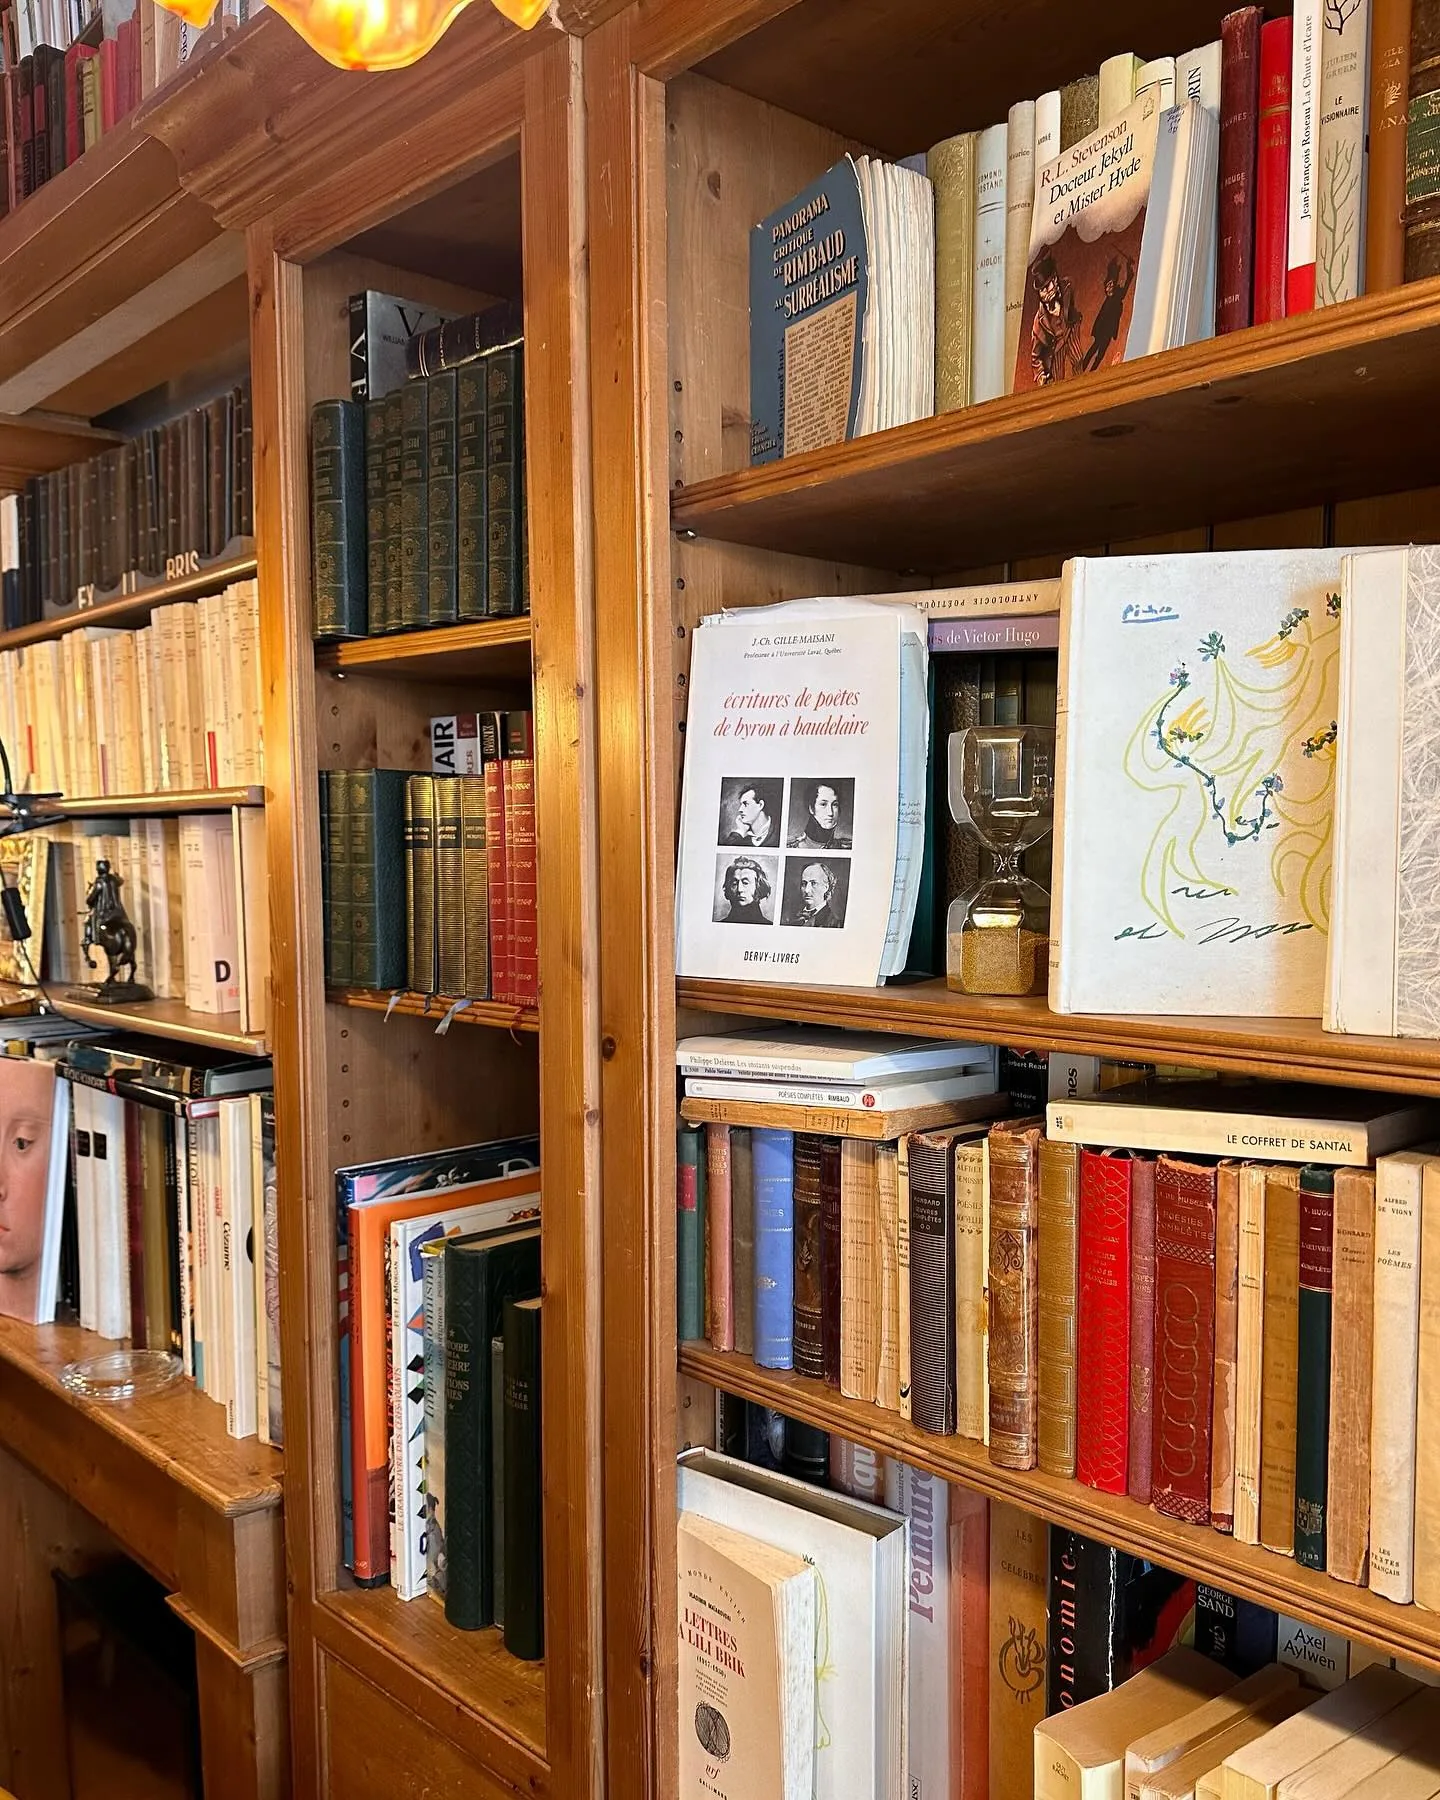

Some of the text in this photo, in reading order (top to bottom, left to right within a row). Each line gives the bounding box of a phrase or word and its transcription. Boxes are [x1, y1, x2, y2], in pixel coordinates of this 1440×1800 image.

[1326, 51, 1357, 69] JULIEN
[1325, 63, 1357, 80] GREEN
[1335, 96, 1343, 106] LE
[1301, 15, 1312, 220] Jean-François Roseau La Chute d'Icare
[1320, 105, 1360, 126] VISIONNAIRE
[1040, 161, 1068, 188] R.L.
[1071, 120, 1127, 168] Stevenson
[1049, 133, 1134, 205] Docteur Jekyll
[1053, 157, 1142, 225] et Mister Hyde
[772, 193, 830, 245] PANORAMA
[773, 227, 815, 263] CRITIQUE
[773, 228, 846, 287] DE RIMBAUD
[775, 255, 859, 320] AU SURRÉALISME
[973, 593, 1039, 606] ANTHOLOGIE
[946, 631, 961, 645] de
[963, 628, 1002, 643] Victor
[1004, 626, 1040, 647] Hugo
[723, 686, 860, 712] écritures de poètes
[713, 713, 870, 741] de byron à baudelaire
[434, 720, 456, 771] AIR
[743, 950, 801, 964] DERVY-LIVRES
[690, 1055, 713, 1066] Philippe
[1028, 1062, 1047, 1070] Read
[828, 1093, 850, 1103] RIMBAUD
[1227, 1134, 1353, 1152] LE COFFRET DE SANTAL
[1378, 1205, 1413, 1217] DE VIGNY
[1384, 1197, 1408, 1206] ALFRED
[223, 1221, 232, 1271] Cézanne
[1387, 1249, 1401, 1257] LES
[395, 1433, 403, 1453] DES
[395, 1455, 403, 1482] LIVRE
[896, 1473, 904, 1512] ionnaire
[396, 1519, 404, 1532] LE
[1015, 1528, 1033, 1543] LES
[1371, 1552, 1401, 1568] TEXTES
[1378, 1547, 1391, 1557] LES
[1197, 1585, 1234, 1606] GEORGE
[1198, 1595, 1235, 1618] SAND
[684, 1607, 738, 1653] LETTRES
[1060, 1553, 1077, 1709] onomie
[1293, 1628, 1326, 1652] Axel
[688, 1629, 712, 1657] LILI
[716, 1645, 746, 1679] BRIK
[1284, 1640, 1337, 1672] Aylwen
